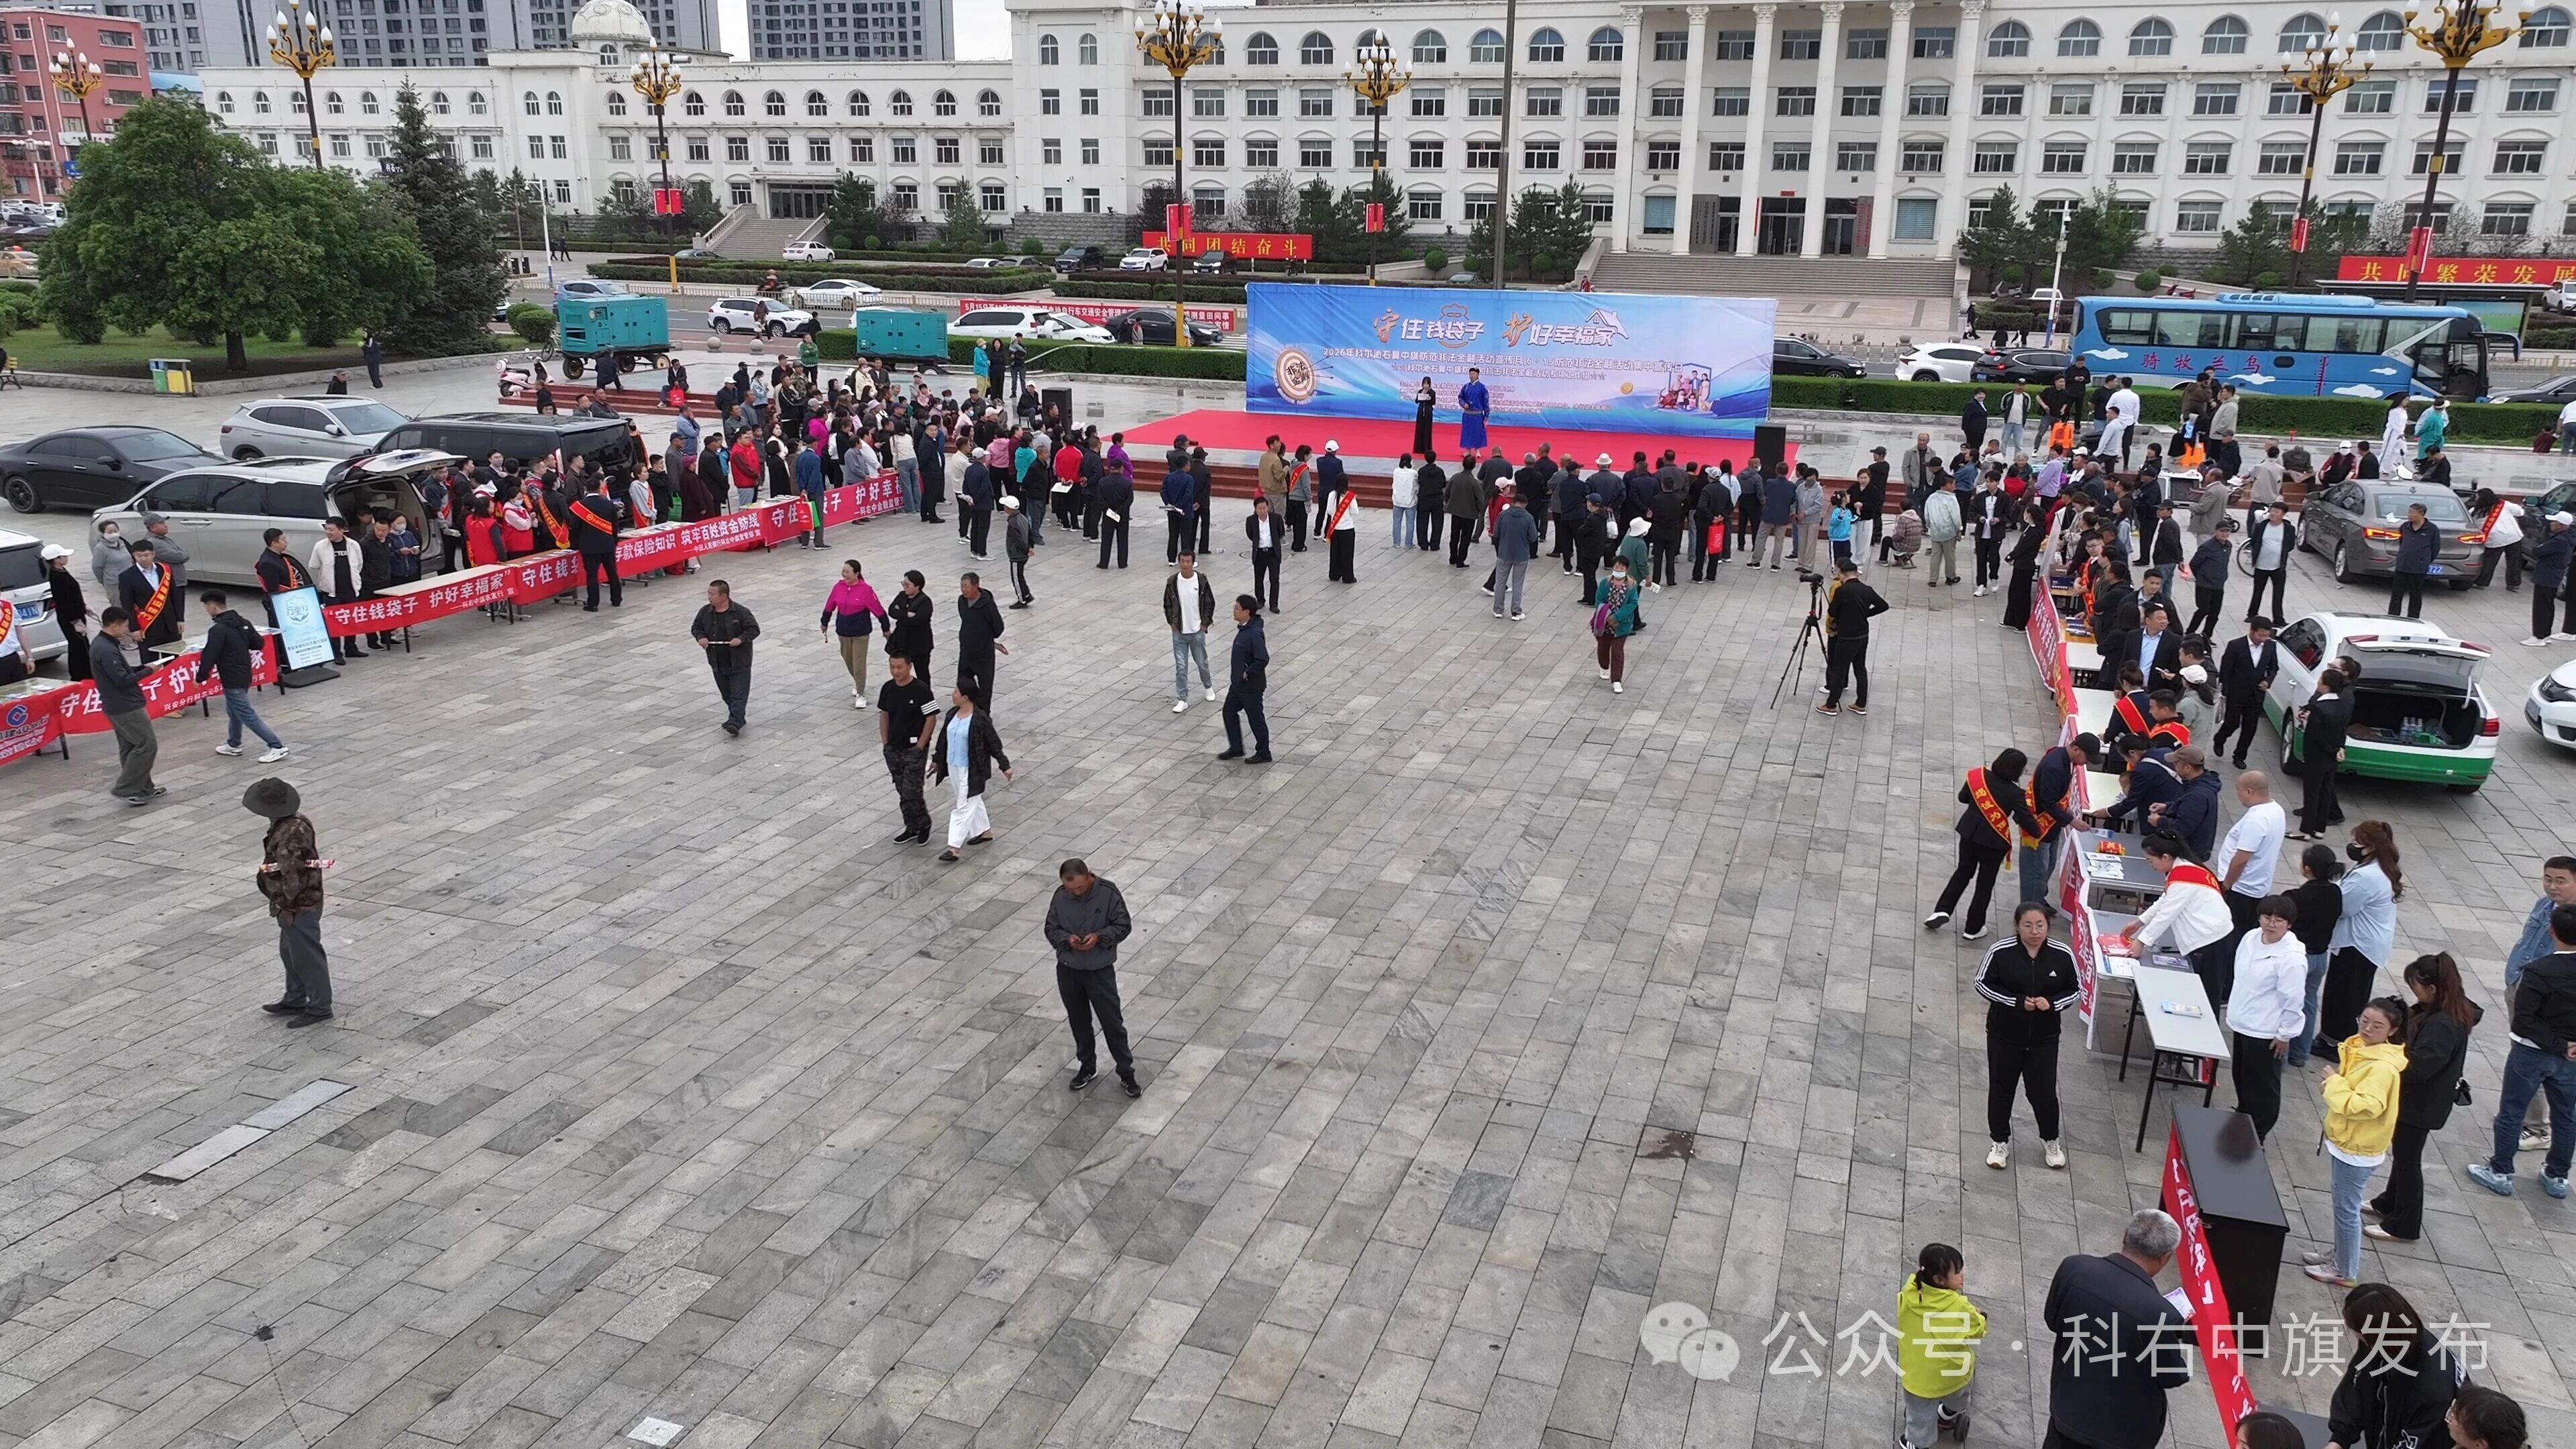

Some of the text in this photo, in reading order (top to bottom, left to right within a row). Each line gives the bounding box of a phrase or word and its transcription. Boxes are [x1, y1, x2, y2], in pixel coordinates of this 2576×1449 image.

[1157, 235, 1297, 256] 共同团结奋斗
[1373, 307, 1617, 347] 守住钱袋子 护好幸福家
[681, 513, 760, 545] 筑牢百姓资金防线
[60, 677, 162, 718] 守住子
